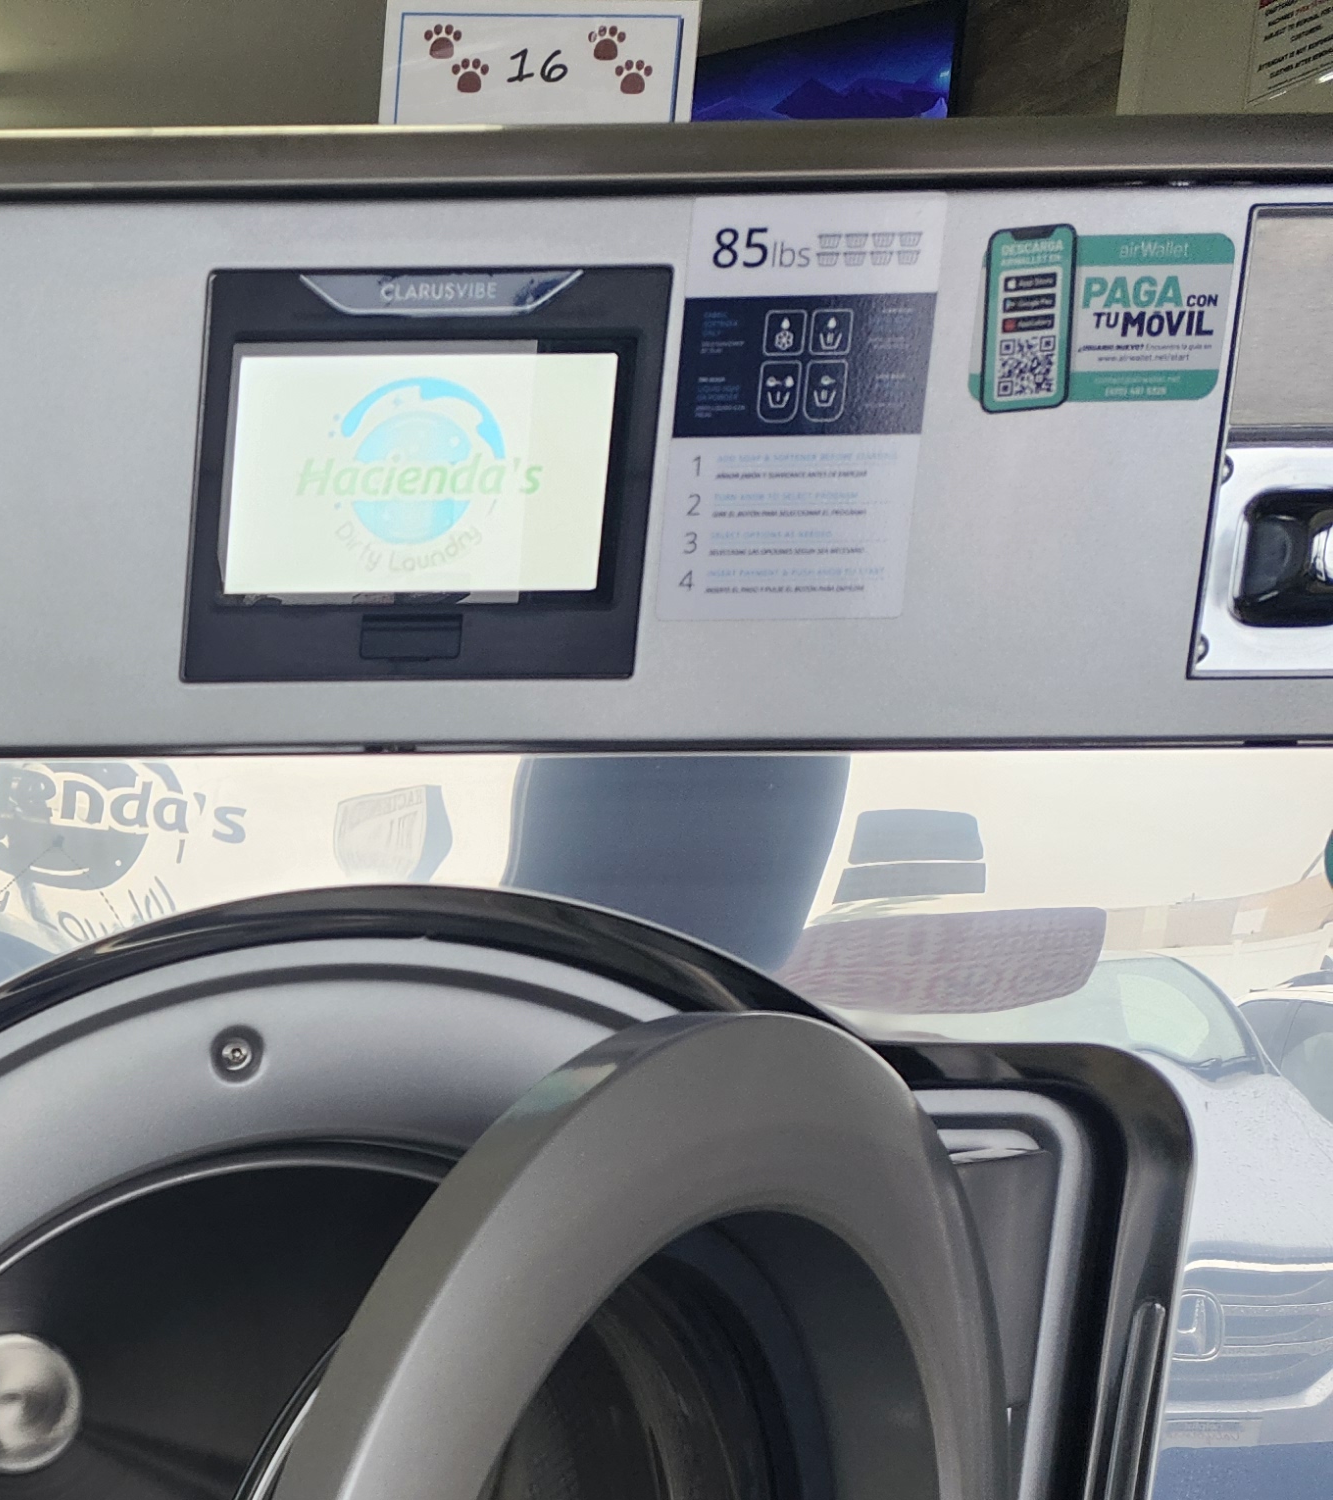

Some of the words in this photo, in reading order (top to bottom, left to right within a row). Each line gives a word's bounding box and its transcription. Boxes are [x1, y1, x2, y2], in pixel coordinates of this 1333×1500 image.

[507, 48, 568, 83] 16
[1120, 240, 1189, 258] airWallet
[380, 282, 497, 301] CLARUSVIBE
[1082, 275, 1184, 309] PAGA
[1186, 294, 1218, 307] CON
[1093, 312, 1120, 329] TU
[1121, 310, 1214, 337] MÓVIL
[296, 454, 543, 497] Hacienda's
[692, 456, 702, 477] 1
[686, 493, 702, 517] 2
[334, 520, 381, 572] Dirty
[388, 525, 483, 573] Laundry
[683, 532, 698, 554] 3
[678, 570, 694, 591] 4
